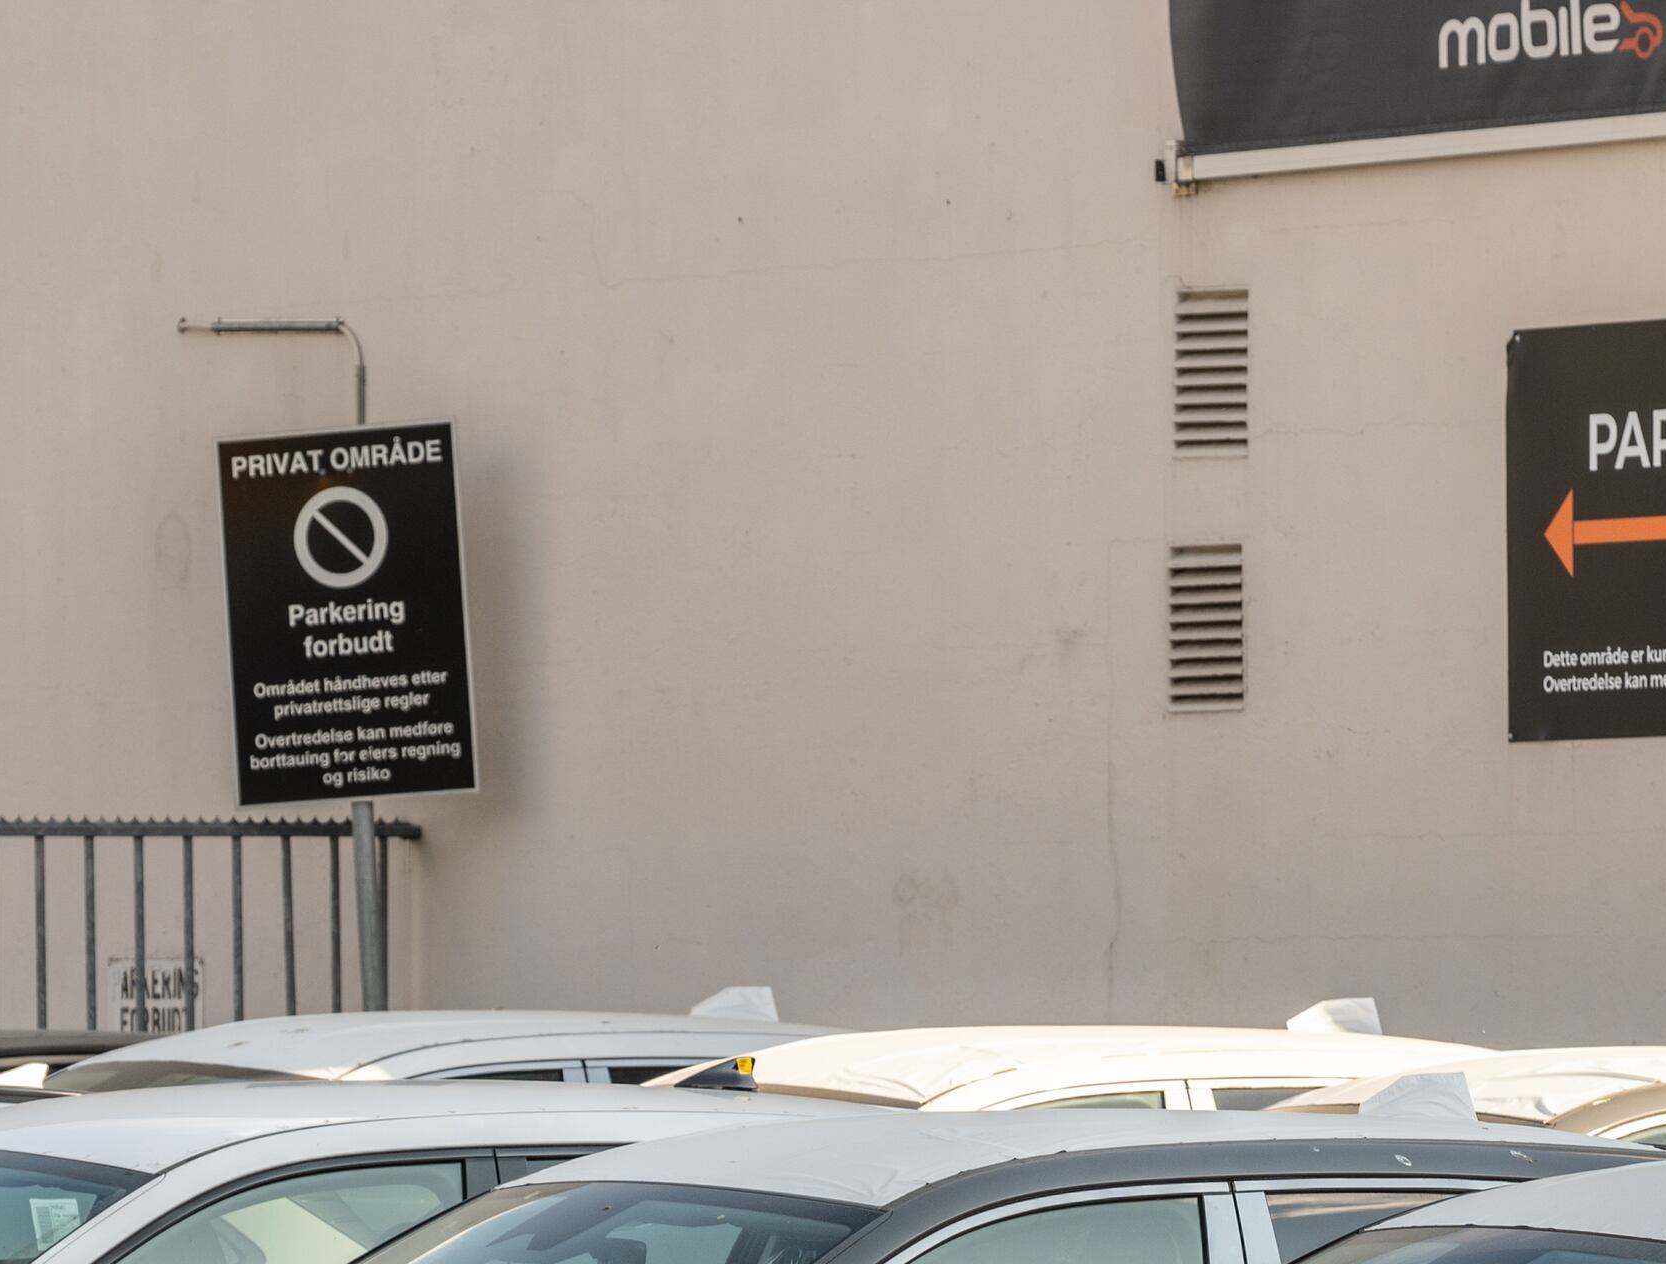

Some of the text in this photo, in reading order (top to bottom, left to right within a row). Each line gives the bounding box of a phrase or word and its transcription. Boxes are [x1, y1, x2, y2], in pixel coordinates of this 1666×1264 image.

[1438, 0, 1621, 69] mobile
[231, 436, 442, 479] PRIVAT OMRÅDE
[288, 598, 405, 628] Parkering
[303, 630, 394, 659] forbudt
[1543, 650, 1578, 668] Dette
[1580, 645, 1629, 667] område
[1631, 648, 1644, 664] er
[253, 670, 448, 698] Området håndheves etter
[1543, 672, 1622, 693] Overtredelse
[1624, 671, 1648, 689] kan
[274, 691, 431, 720] privatrettslige regler
[255, 728, 354, 749] Overtredelse
[357, 725, 386, 741] kan
[250, 741, 462, 770] borttauing for eiers regning
[322, 766, 391, 788] og risiko
